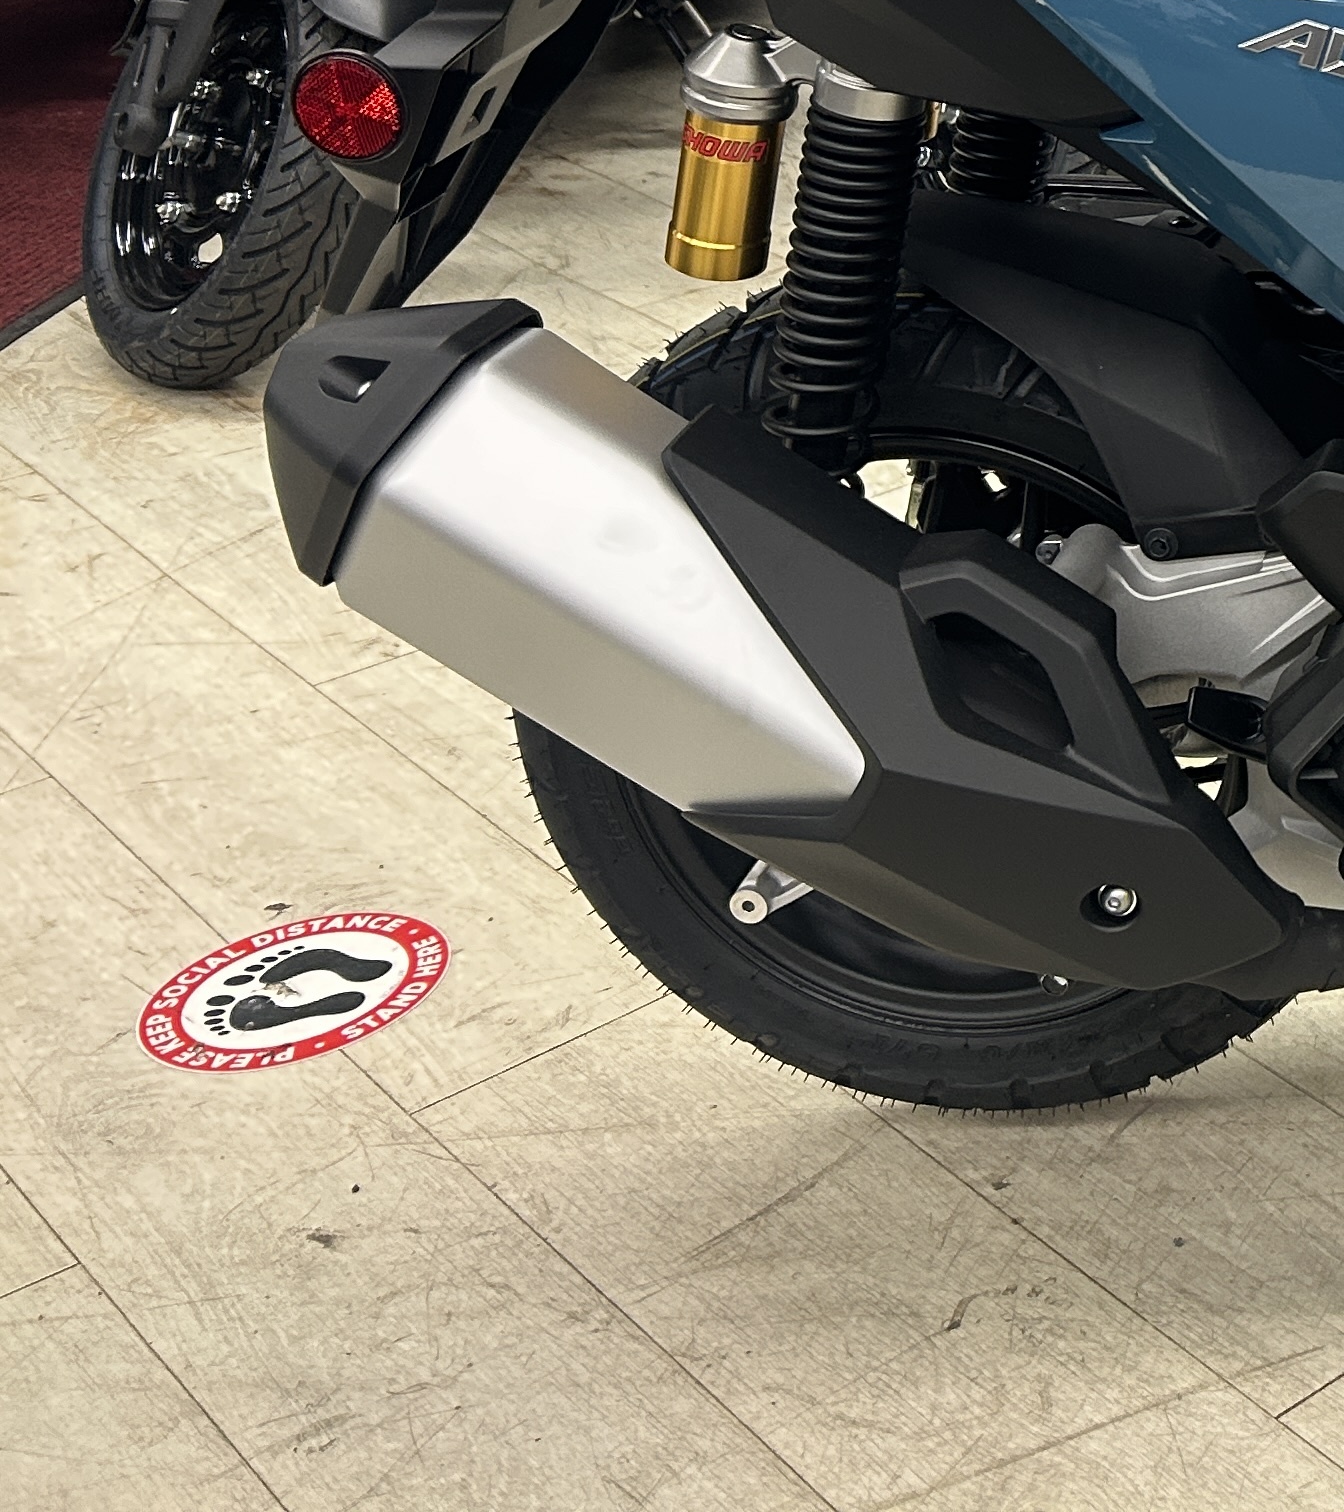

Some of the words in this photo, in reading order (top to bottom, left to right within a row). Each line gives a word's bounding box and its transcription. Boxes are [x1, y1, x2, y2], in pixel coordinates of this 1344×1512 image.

[250, 914, 408, 947] DISTANCE
[153, 945, 246, 1008] SOCIAL
[341, 981, 428, 1040] STAND
[411, 935, 446, 977] HERE
[146, 1014, 186, 1055] KEEP
